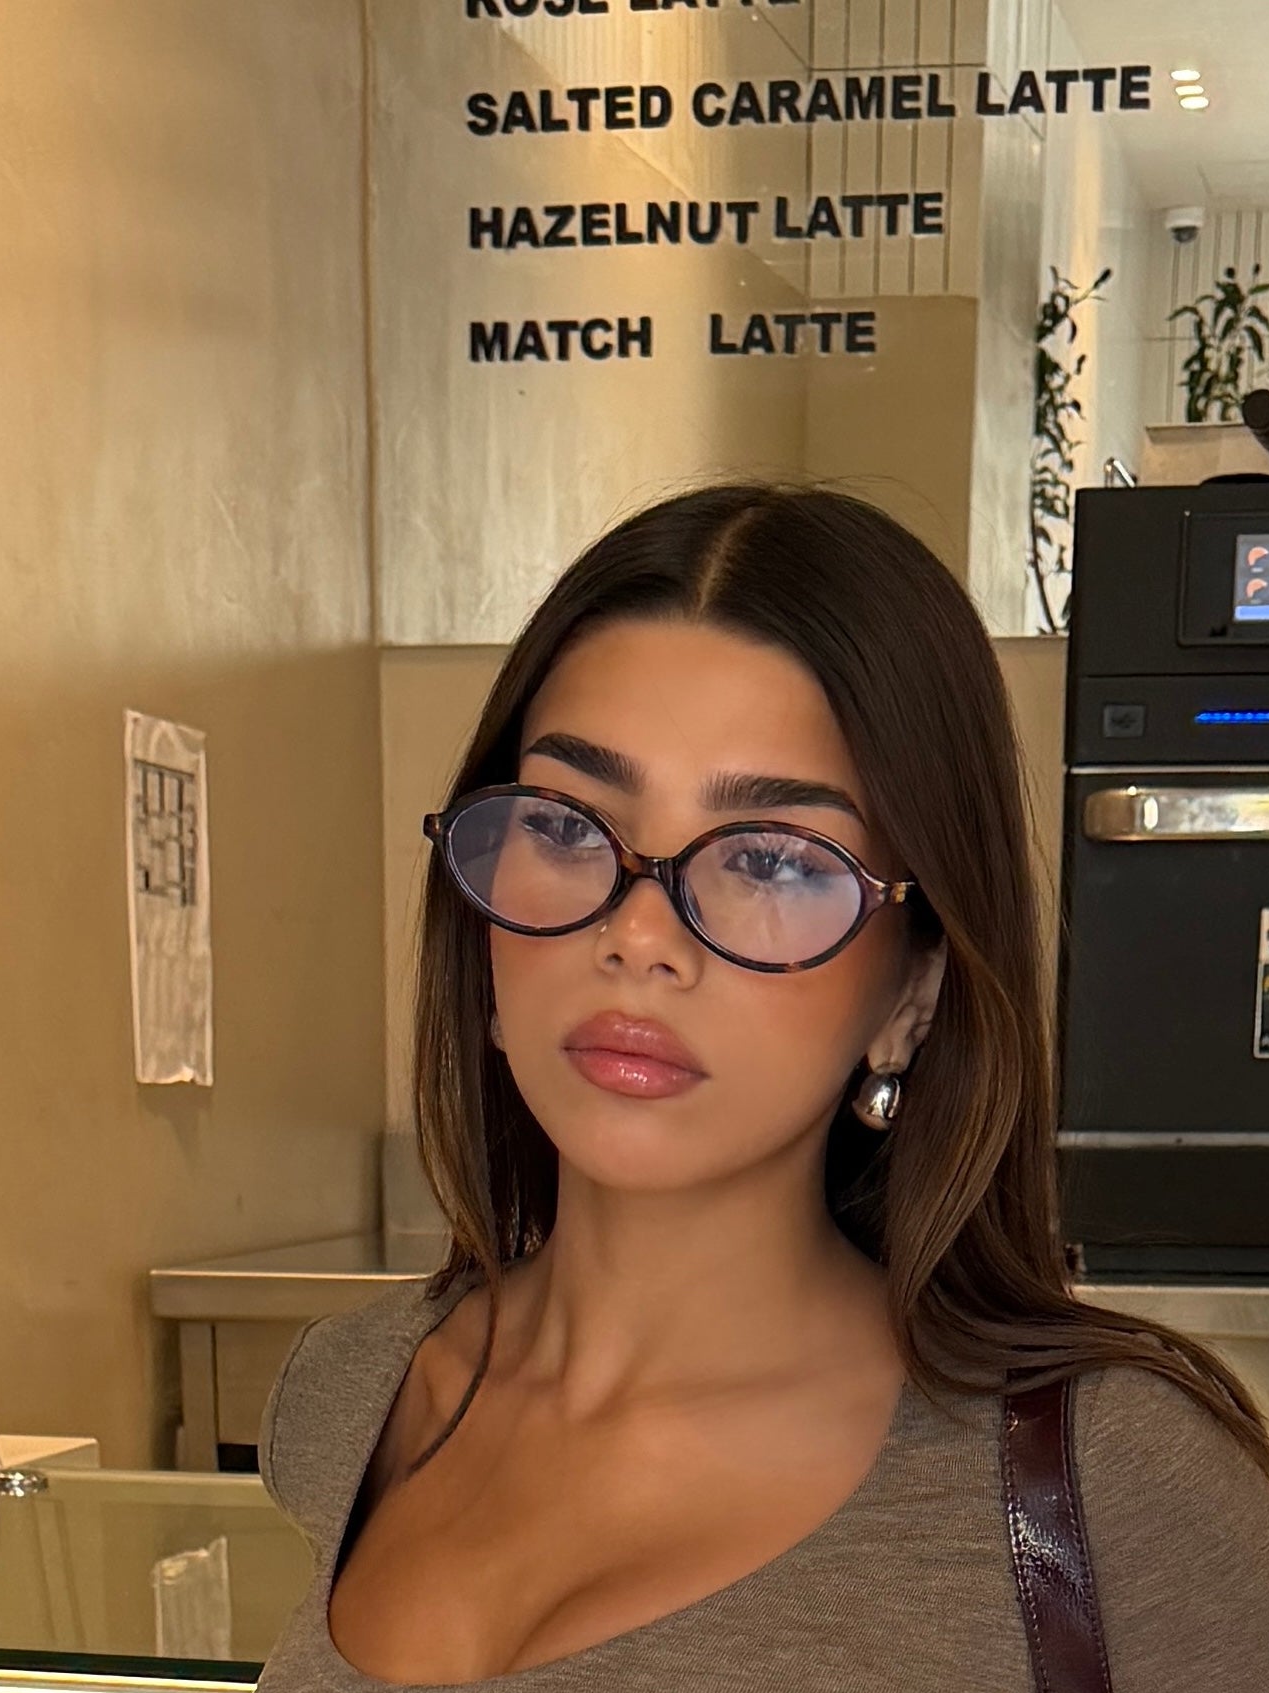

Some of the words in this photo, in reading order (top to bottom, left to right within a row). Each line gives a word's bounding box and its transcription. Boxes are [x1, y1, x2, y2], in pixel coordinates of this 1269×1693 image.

[466, 84, 673, 137] SALTED
[691, 74, 956, 127] CARAMEL
[975, 65, 1152, 117] LATTE
[469, 200, 759, 250] HAZELNUT
[775, 192, 945, 240] LATTE
[469, 316, 653, 363] MATCH
[709, 312, 877, 355] LATTE
